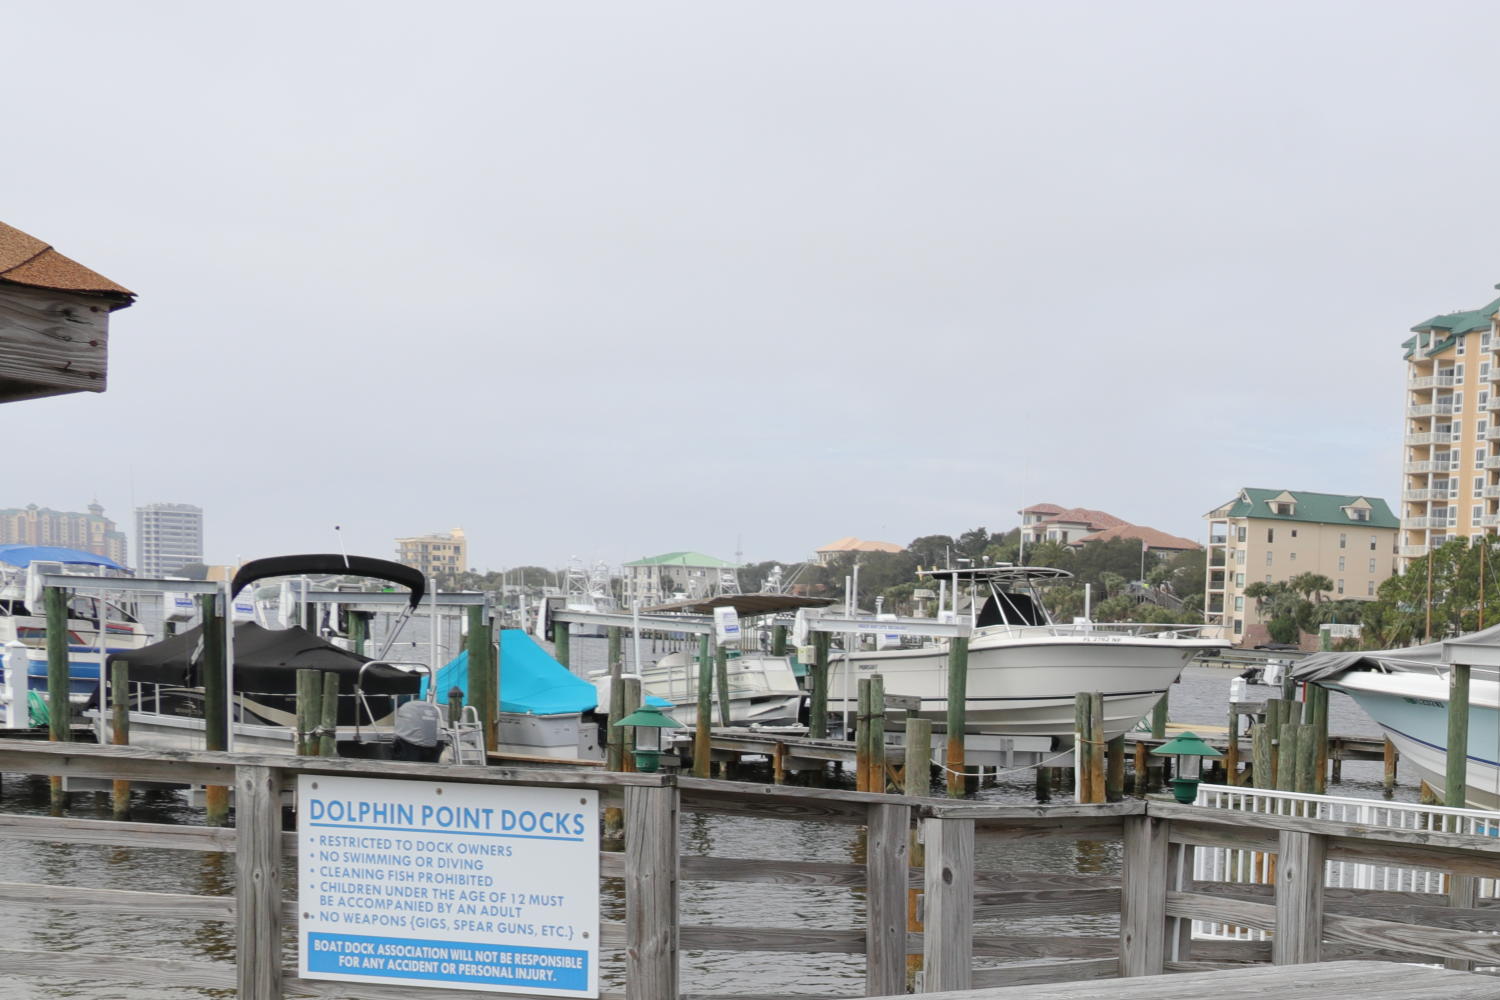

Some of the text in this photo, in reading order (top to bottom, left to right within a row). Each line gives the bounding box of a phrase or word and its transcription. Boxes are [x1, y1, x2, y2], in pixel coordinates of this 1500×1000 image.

[310, 799, 585, 835] DOLPHIN POINT DOCKS
[320, 835, 513, 857] RESTRICTED TO DOCK OWNERS
[320, 850, 484, 871] NO SWIMMING OR DIVING
[320, 866, 494, 887] CLEANING FISH PROHIBITED
[320, 881, 565, 907] CHILDREN UNDER THE AGE OF 12 MUST
[320, 895, 523, 918] BE ACCOMPANIED BY AN ADULT
[320, 911, 574, 941] NO WEAPONS {GIGS, SPEAR GUNS, ETC.}
[313, 939, 583, 969] BOAT DOCK ASSOCIATION WILL NOT BE RESPONSIBLE
[338, 955, 557, 982] FOR ANY ACCIDENT OR PERSONAL INJURY.
